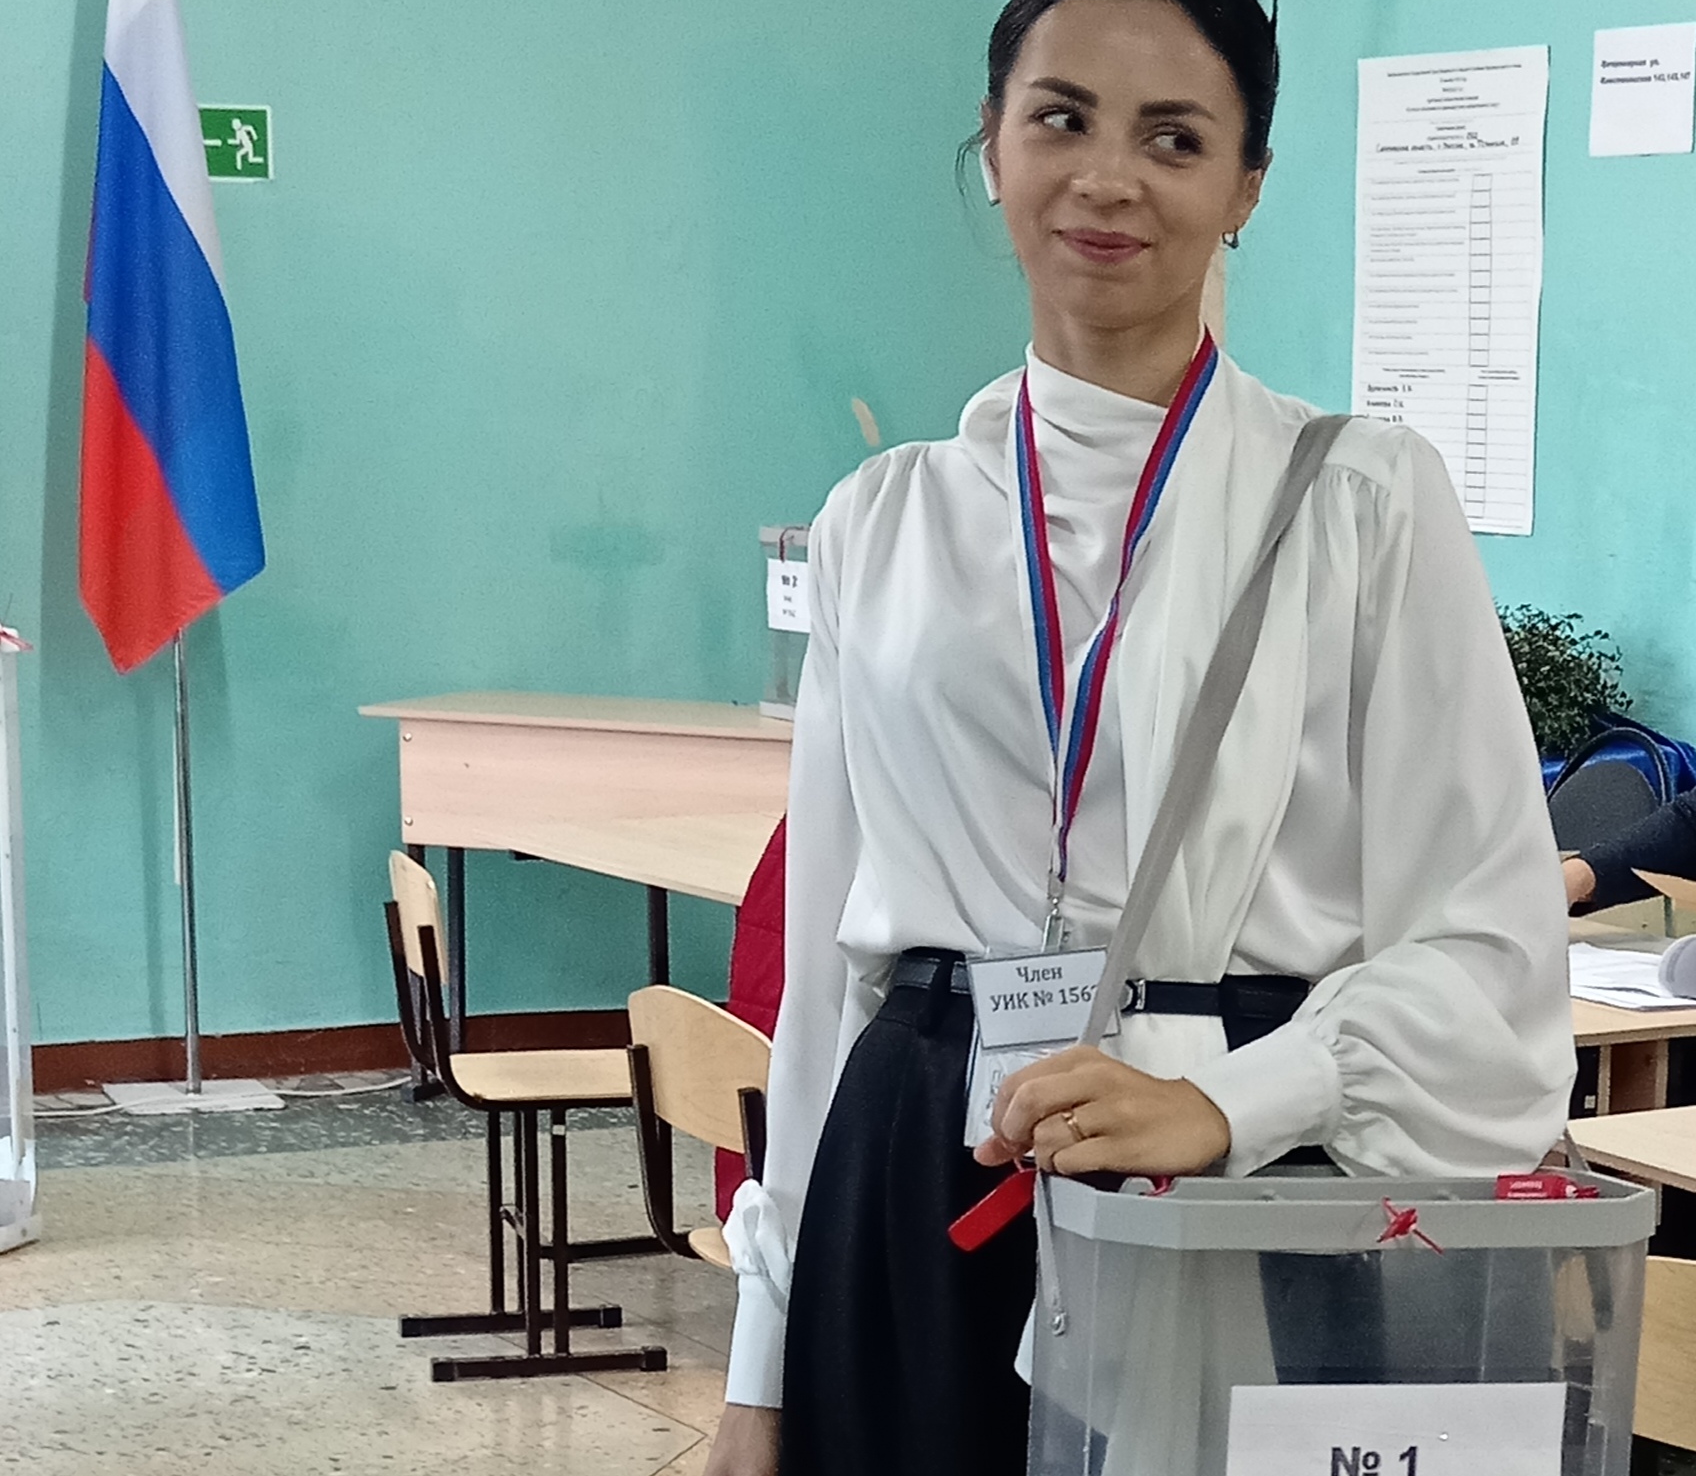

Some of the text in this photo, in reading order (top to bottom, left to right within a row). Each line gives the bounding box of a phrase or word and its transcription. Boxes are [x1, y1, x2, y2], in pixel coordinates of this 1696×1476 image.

[1016, 966, 1063, 983] Член
[990, 984, 1098, 1013] УИК № 156
